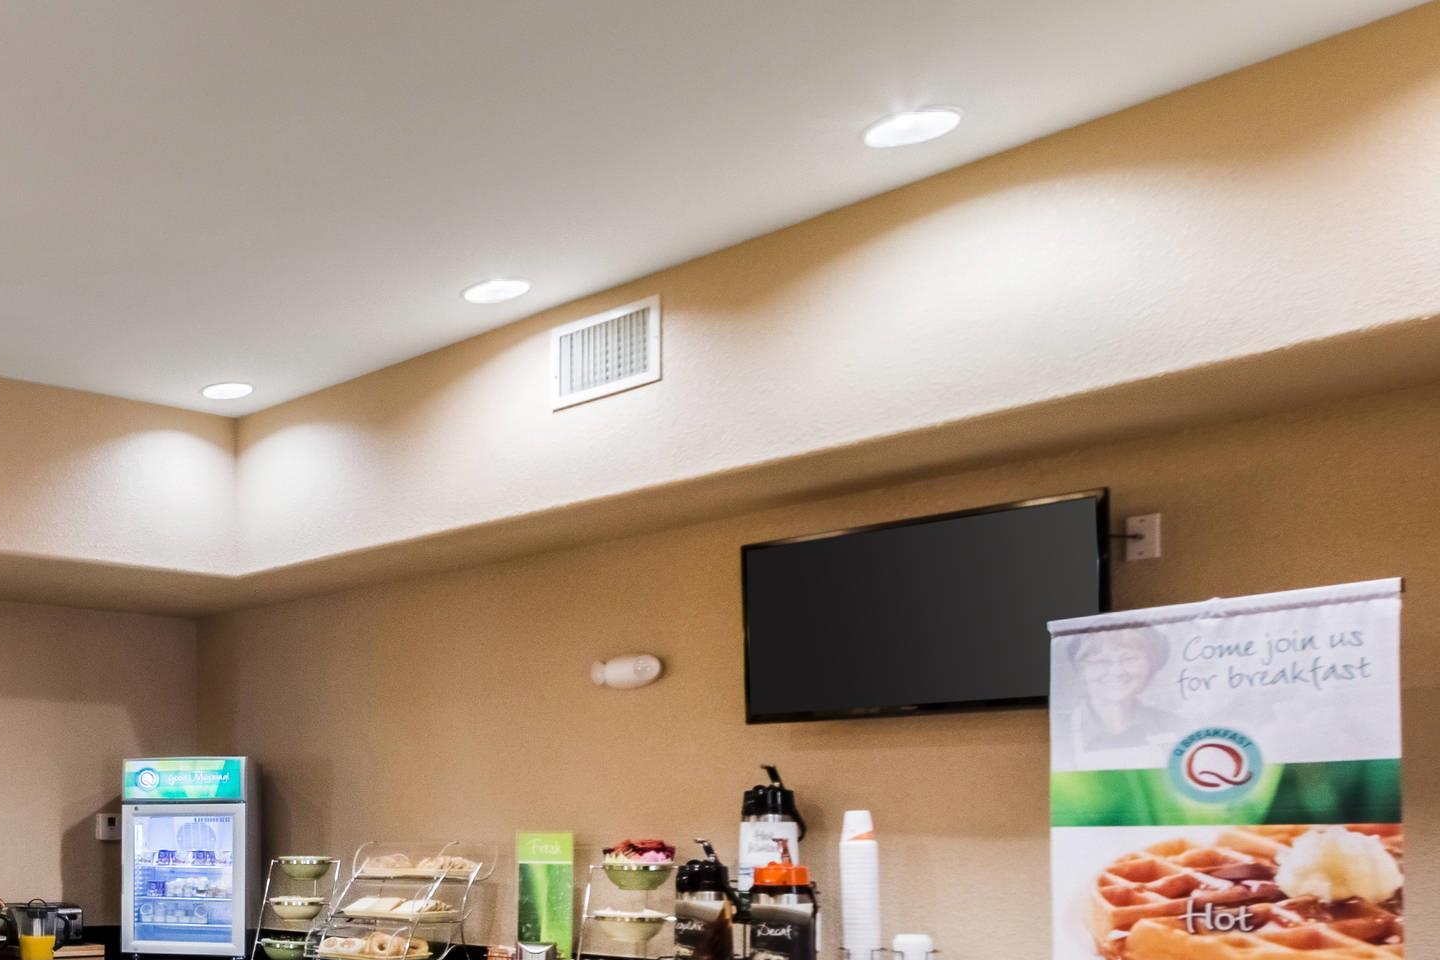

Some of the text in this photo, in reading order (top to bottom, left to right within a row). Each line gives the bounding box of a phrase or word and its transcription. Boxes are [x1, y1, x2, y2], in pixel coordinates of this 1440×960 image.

[1183, 630, 1364, 665] Come join us
[1176, 656, 1371, 700] for breakfast
[1179, 727, 1253, 750] BREAKFAST
[1186, 743, 1253, 788] Q
[757, 922, 793, 940] Decaf
[1176, 895, 1254, 934] Hot
